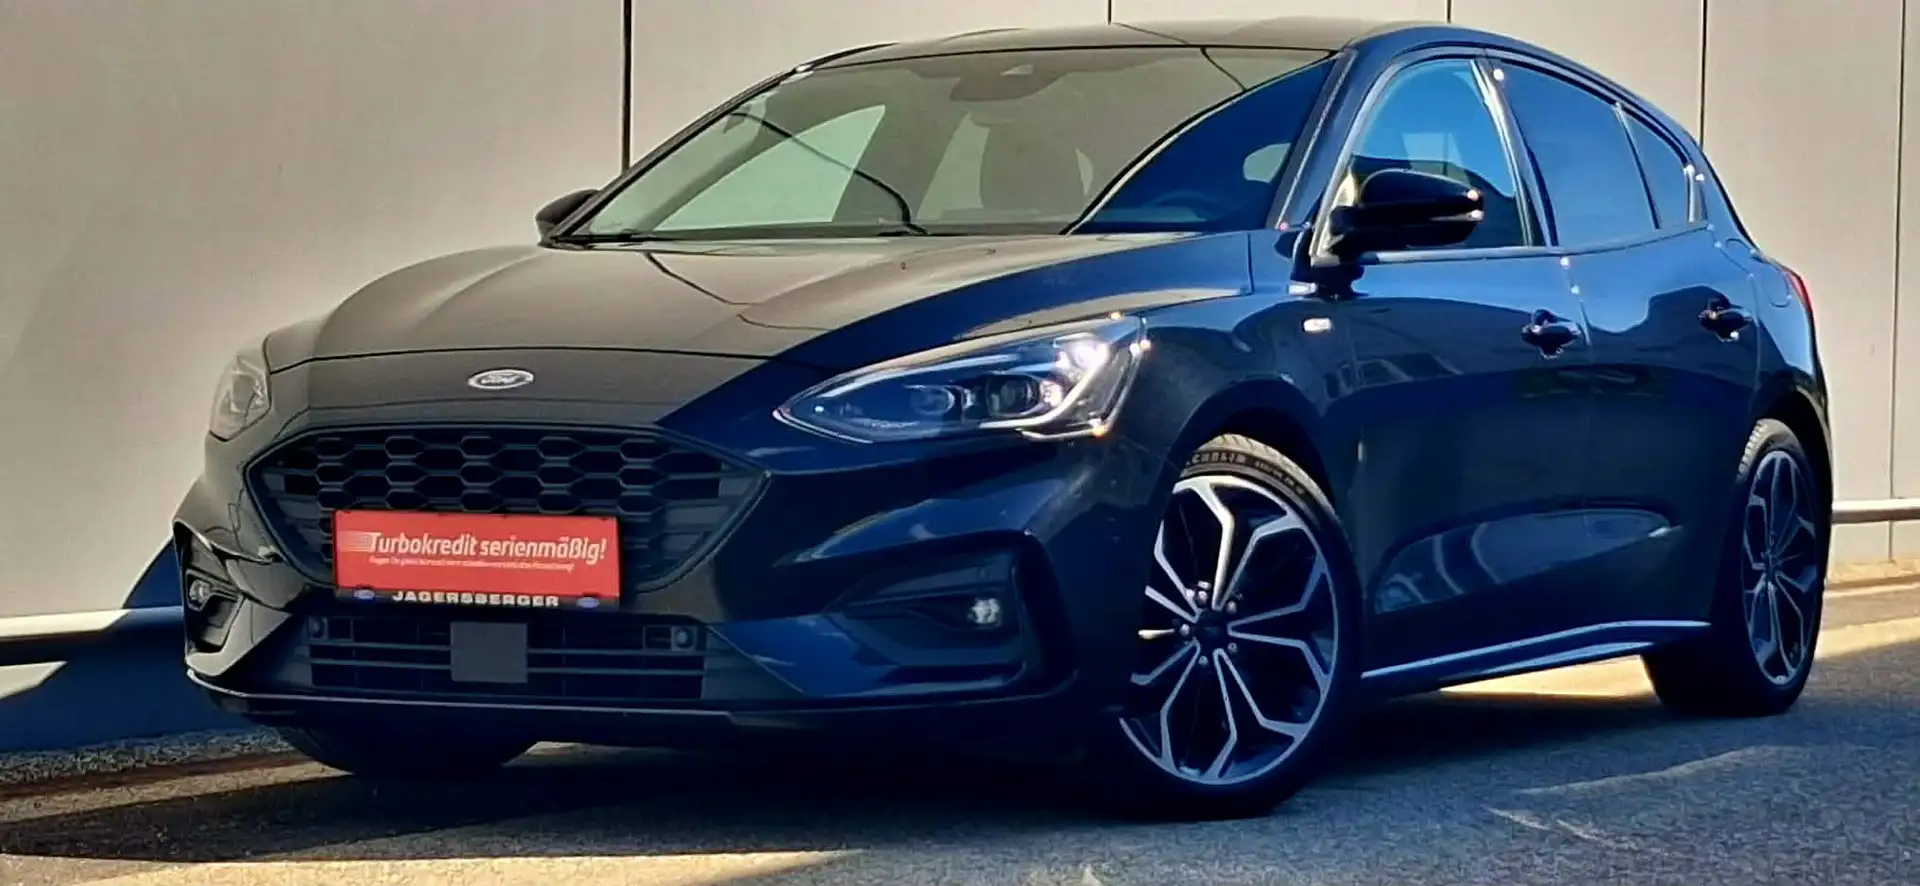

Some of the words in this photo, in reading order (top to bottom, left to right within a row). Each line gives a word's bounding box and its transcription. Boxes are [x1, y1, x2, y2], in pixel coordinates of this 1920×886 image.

[367, 531, 478, 556] Turbokredit
[479, 535, 607, 565] serienmäßig!
[391, 590, 560, 607] JAGERSBERGER
